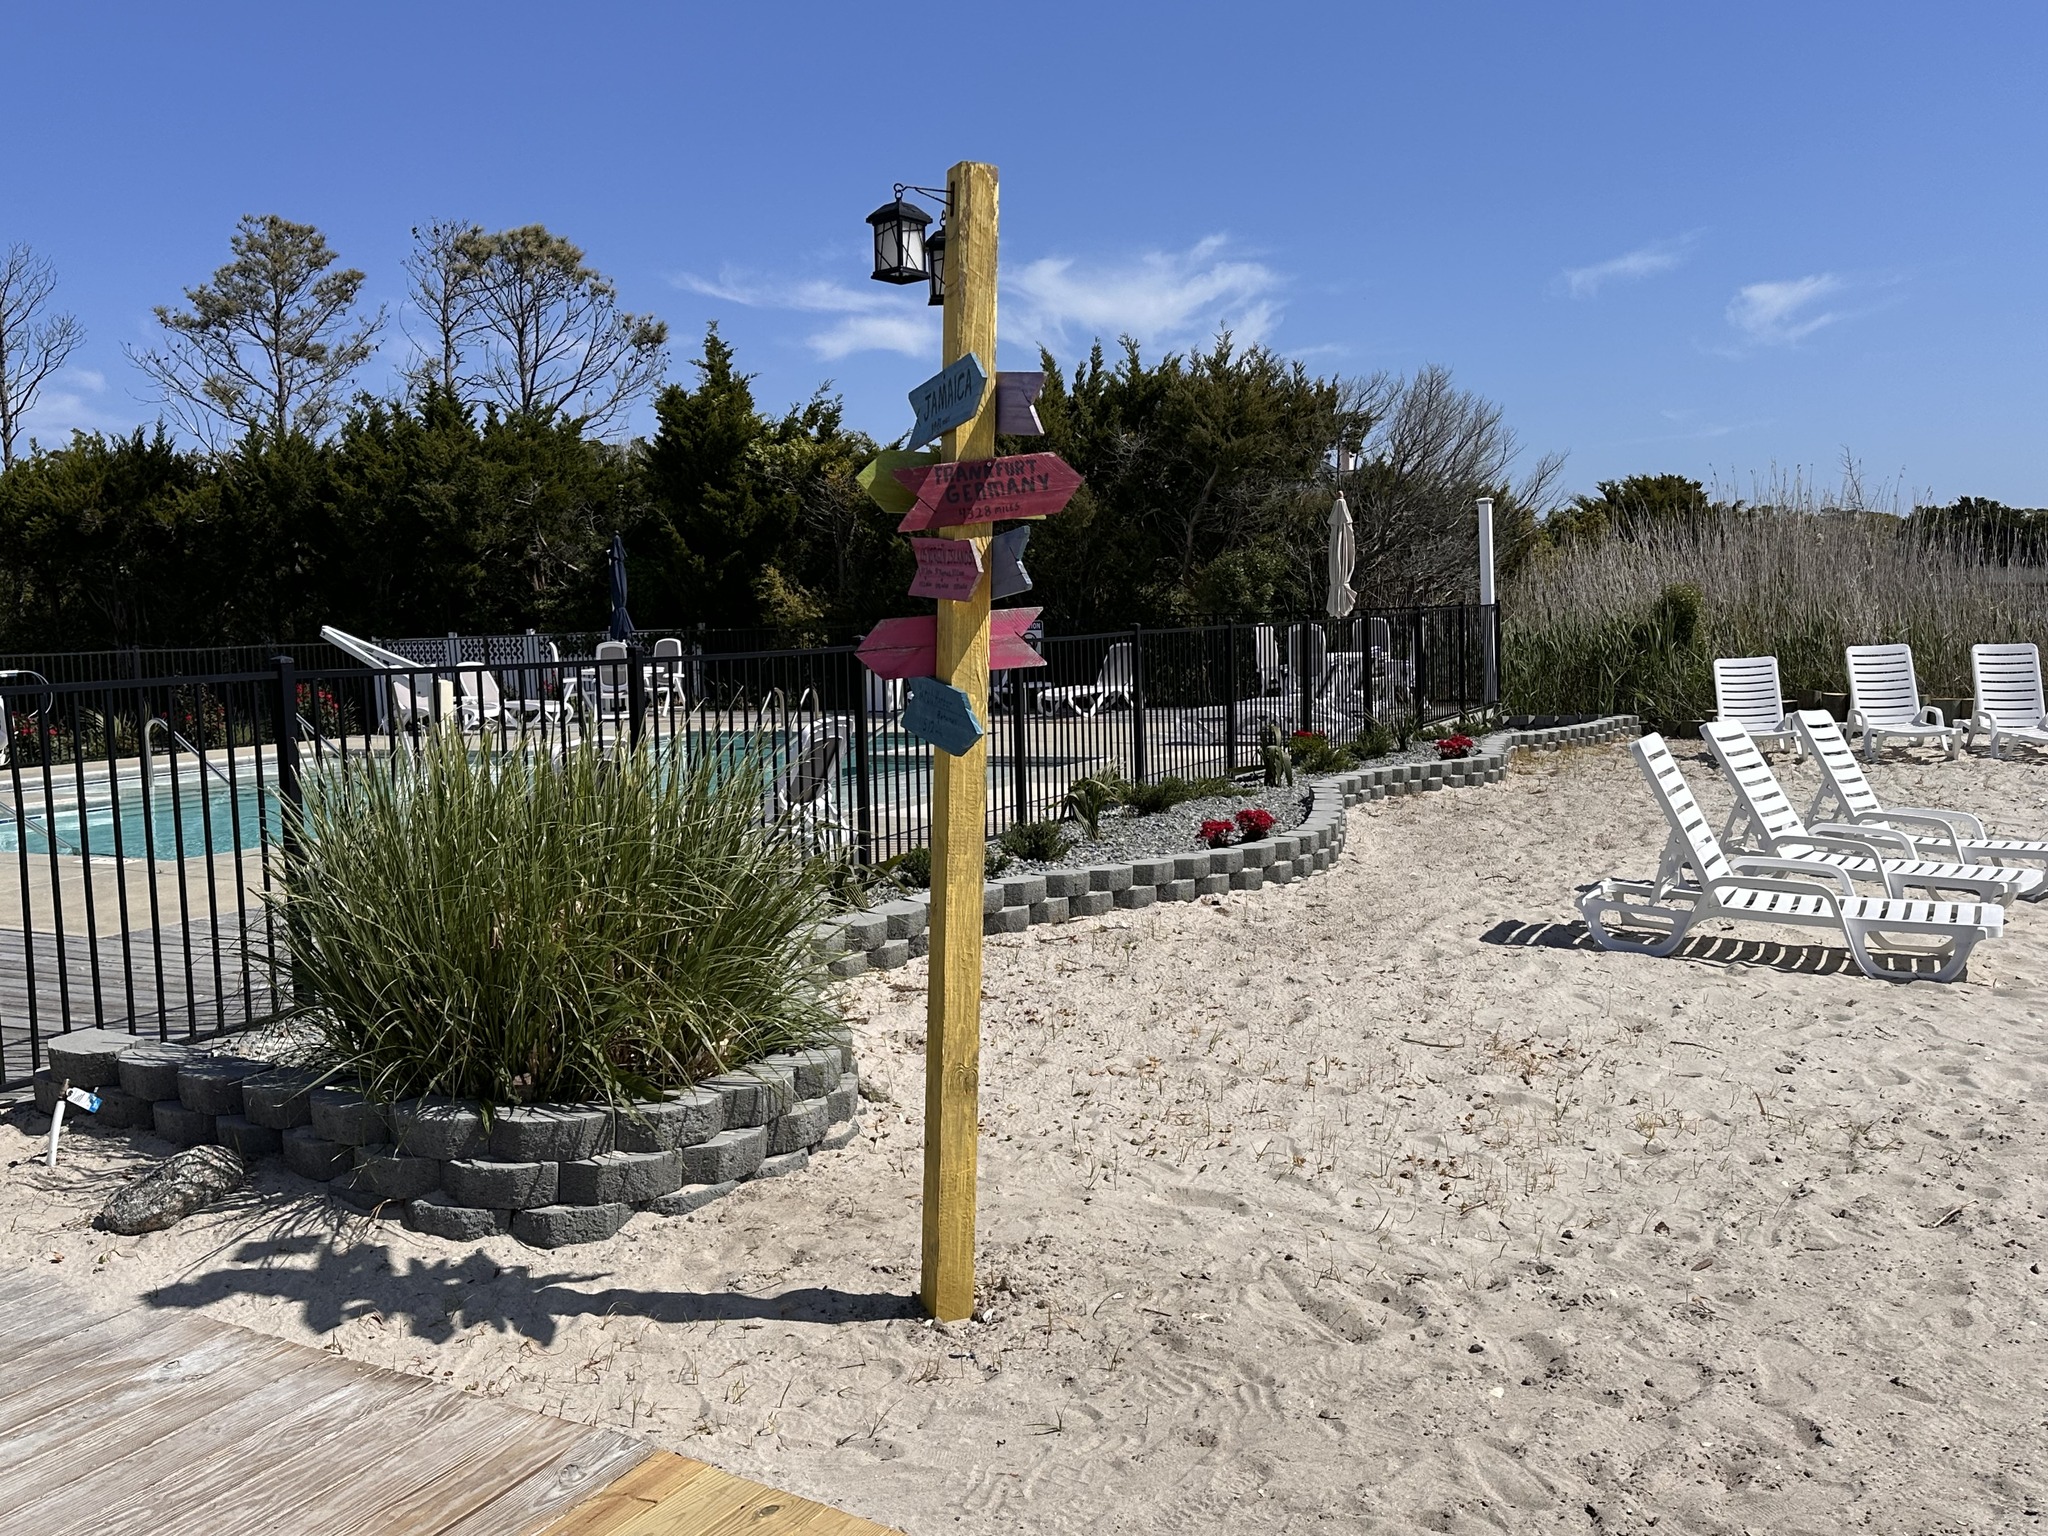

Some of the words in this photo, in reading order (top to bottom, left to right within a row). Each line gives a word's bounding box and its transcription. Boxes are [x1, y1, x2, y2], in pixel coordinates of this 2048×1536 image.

[923, 368, 972, 421] JAMAICA
[934, 459, 1037, 485] FRANKFURT
[945, 472, 1049, 504] GERMANY
